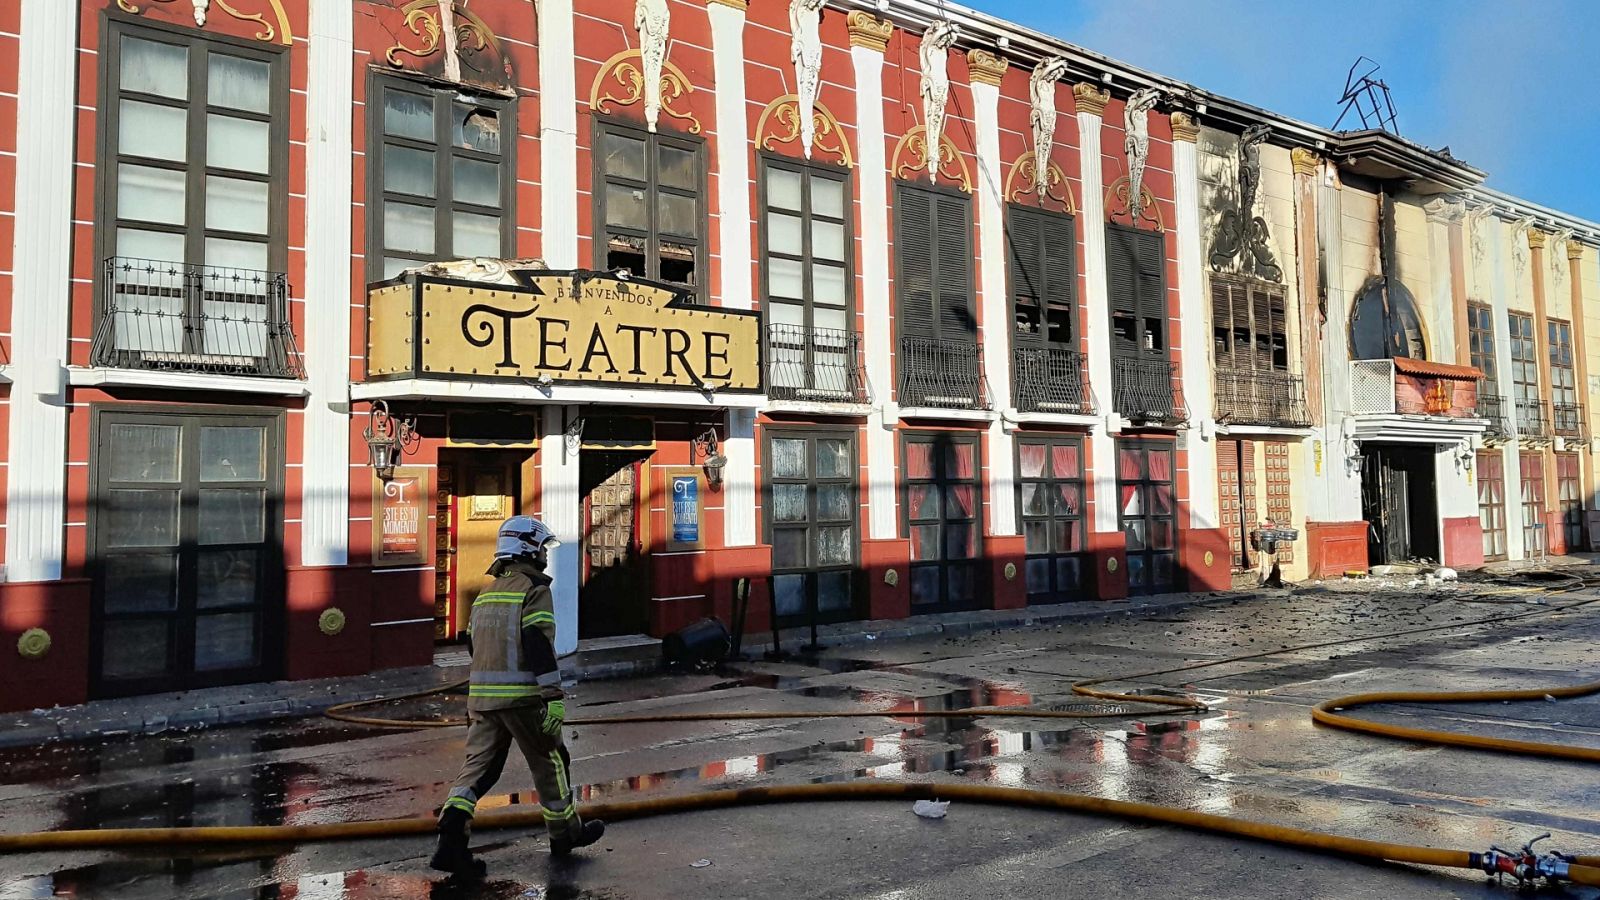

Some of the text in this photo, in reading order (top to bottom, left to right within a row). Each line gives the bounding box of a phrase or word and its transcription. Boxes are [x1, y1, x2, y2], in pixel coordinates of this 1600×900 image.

[557, 287, 653, 307] BINVENIDOS
[604, 305, 613, 315] A
[461, 303, 732, 391] TEATRE
[399, 507, 408, 521] ES
[409, 507, 419, 521] TU
[383, 520, 418, 534] MOMENTO
